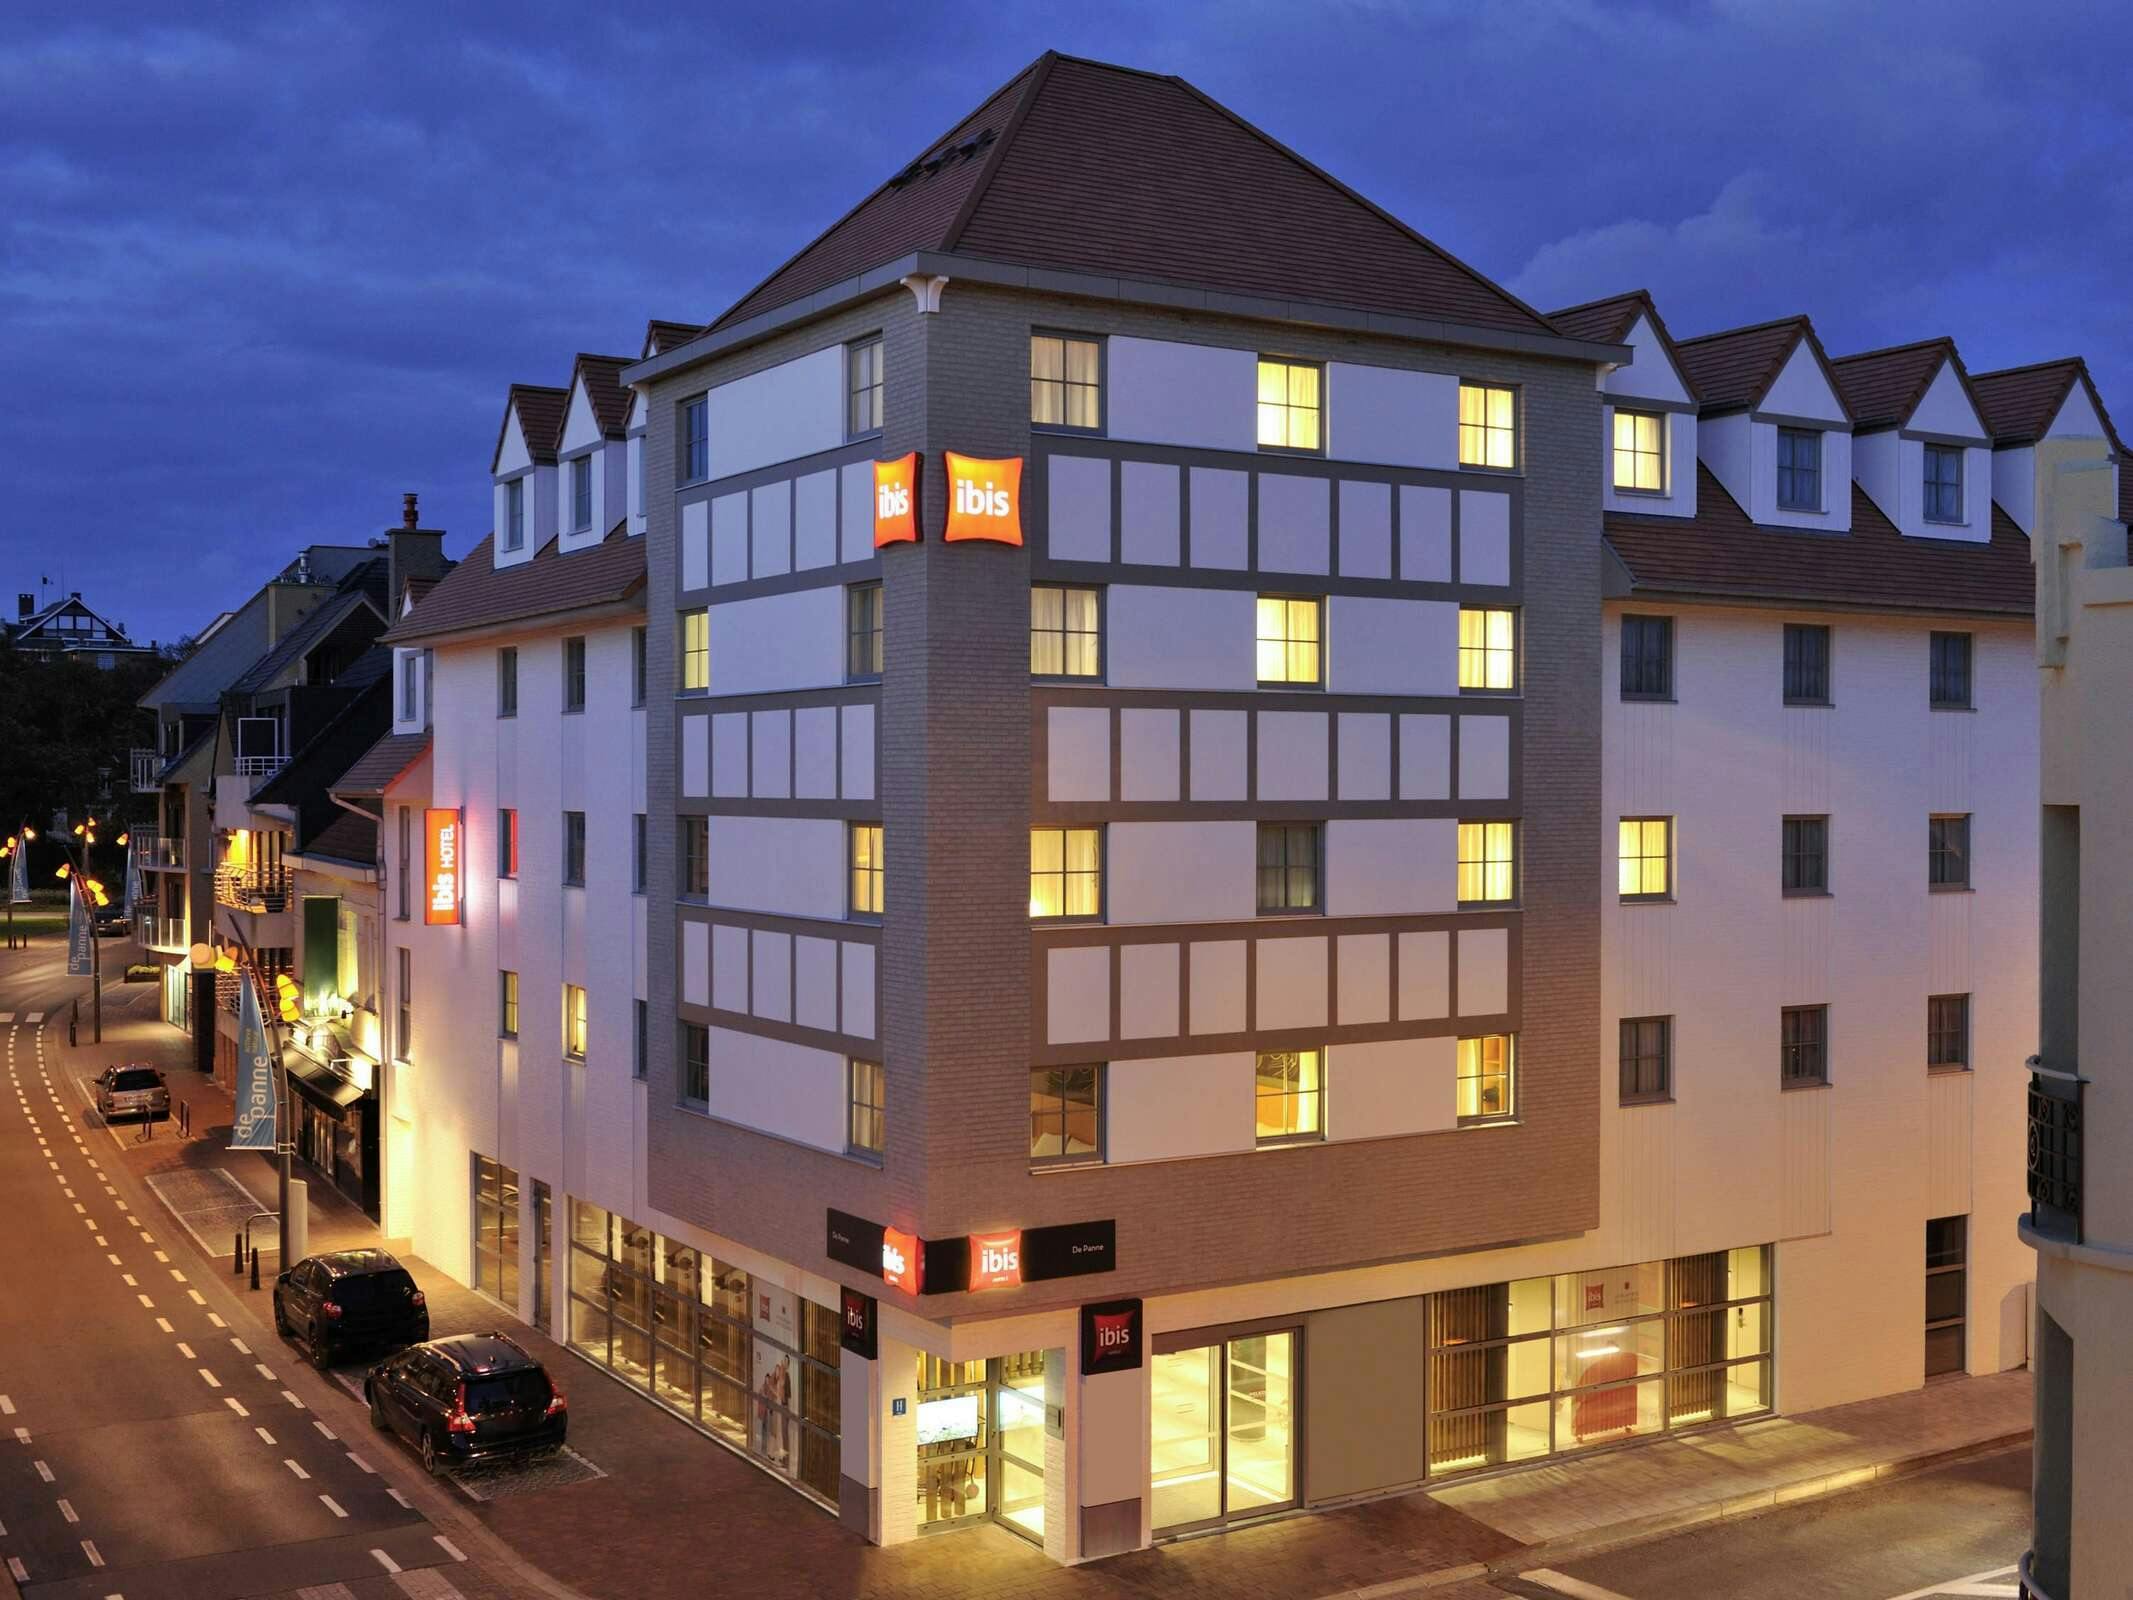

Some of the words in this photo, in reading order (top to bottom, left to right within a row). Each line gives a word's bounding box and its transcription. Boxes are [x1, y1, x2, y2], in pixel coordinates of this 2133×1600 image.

[879, 482, 909, 519] ibis
[956, 479, 1010, 517] ibis
[250, 1056, 275, 1118] panne
[233, 1113, 253, 1139] de
[982, 1247, 1018, 1273] ibis
[847, 1306, 863, 1330] ibis
[1100, 1325, 1129, 1347] ibis
